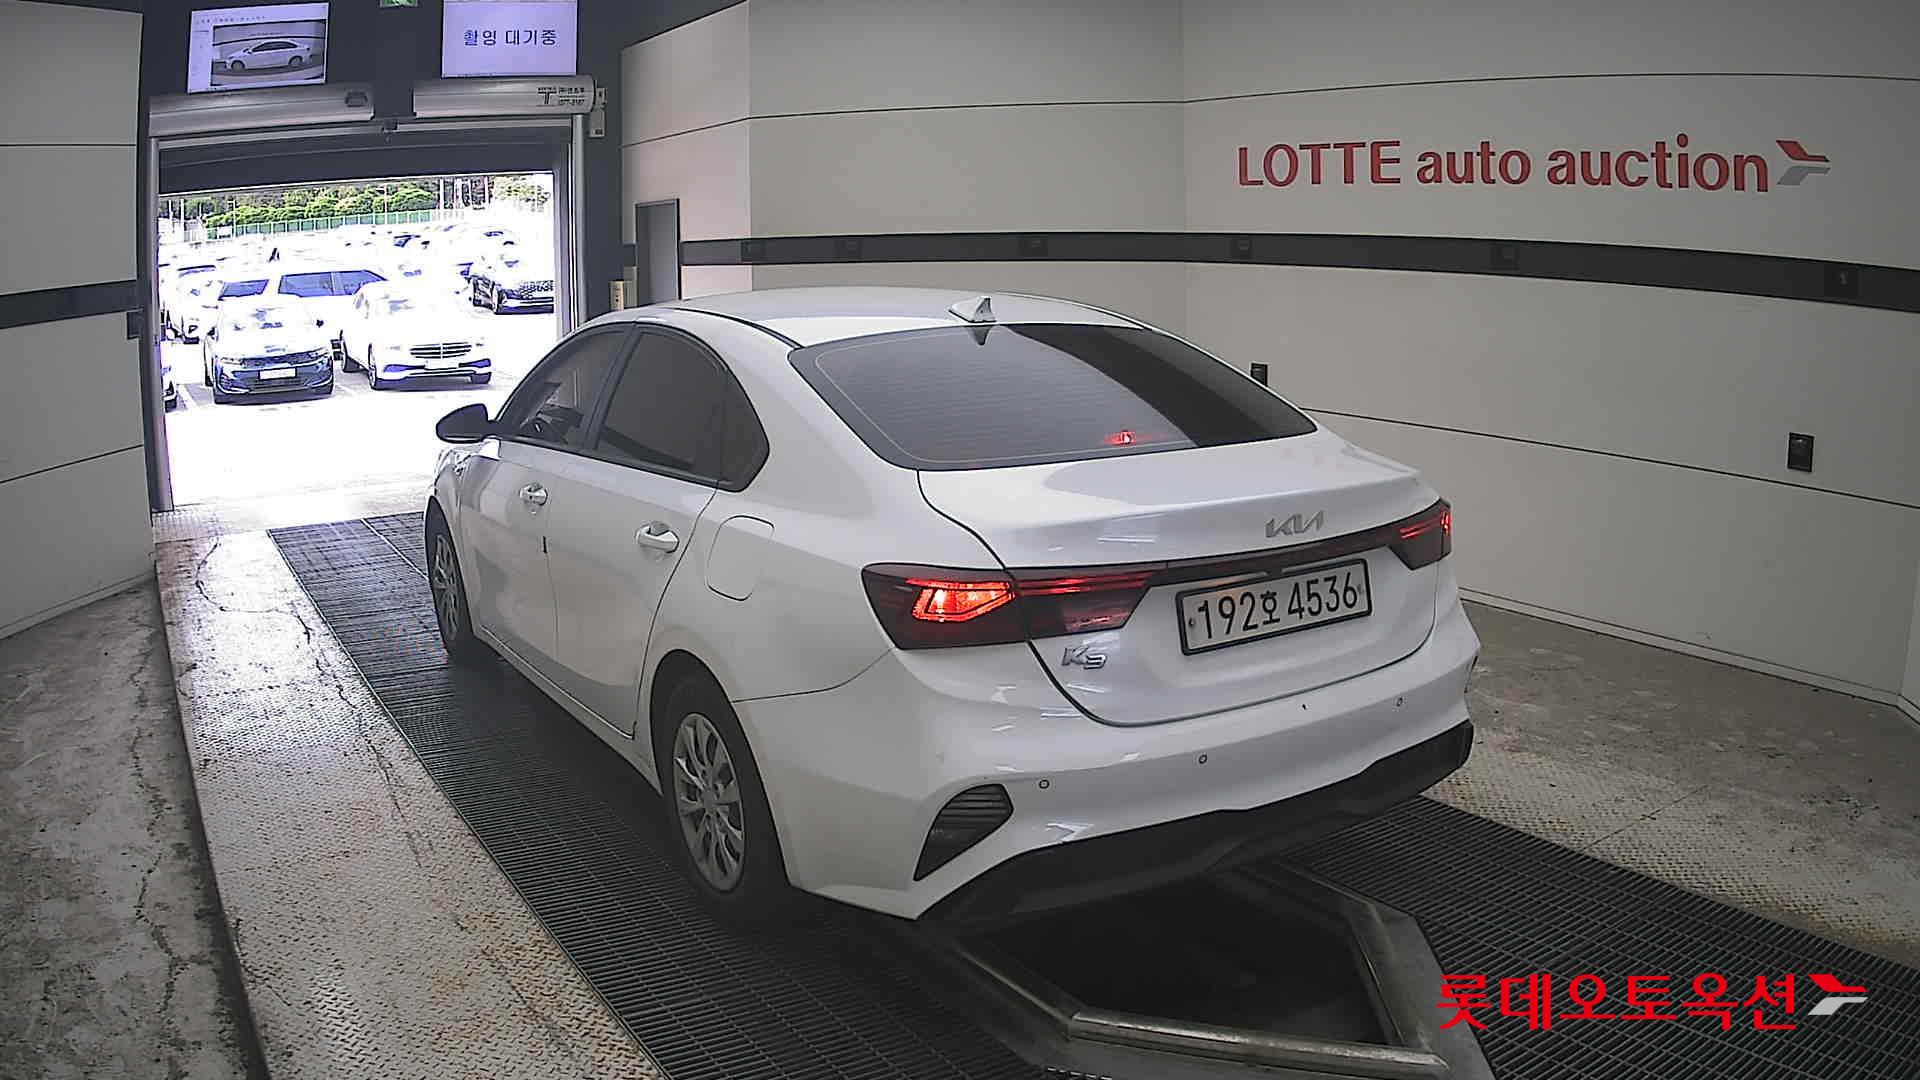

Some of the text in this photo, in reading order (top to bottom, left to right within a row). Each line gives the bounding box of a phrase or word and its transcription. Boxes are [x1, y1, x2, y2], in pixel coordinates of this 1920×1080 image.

[505, 29, 557, 46] 대기중
[1237, 133, 1769, 192] LOTTE auto auction
[1265, 510, 1324, 538] KIA
[1198, 571, 1358, 639] 192호 4536
[1061, 646, 1107, 670] K3
